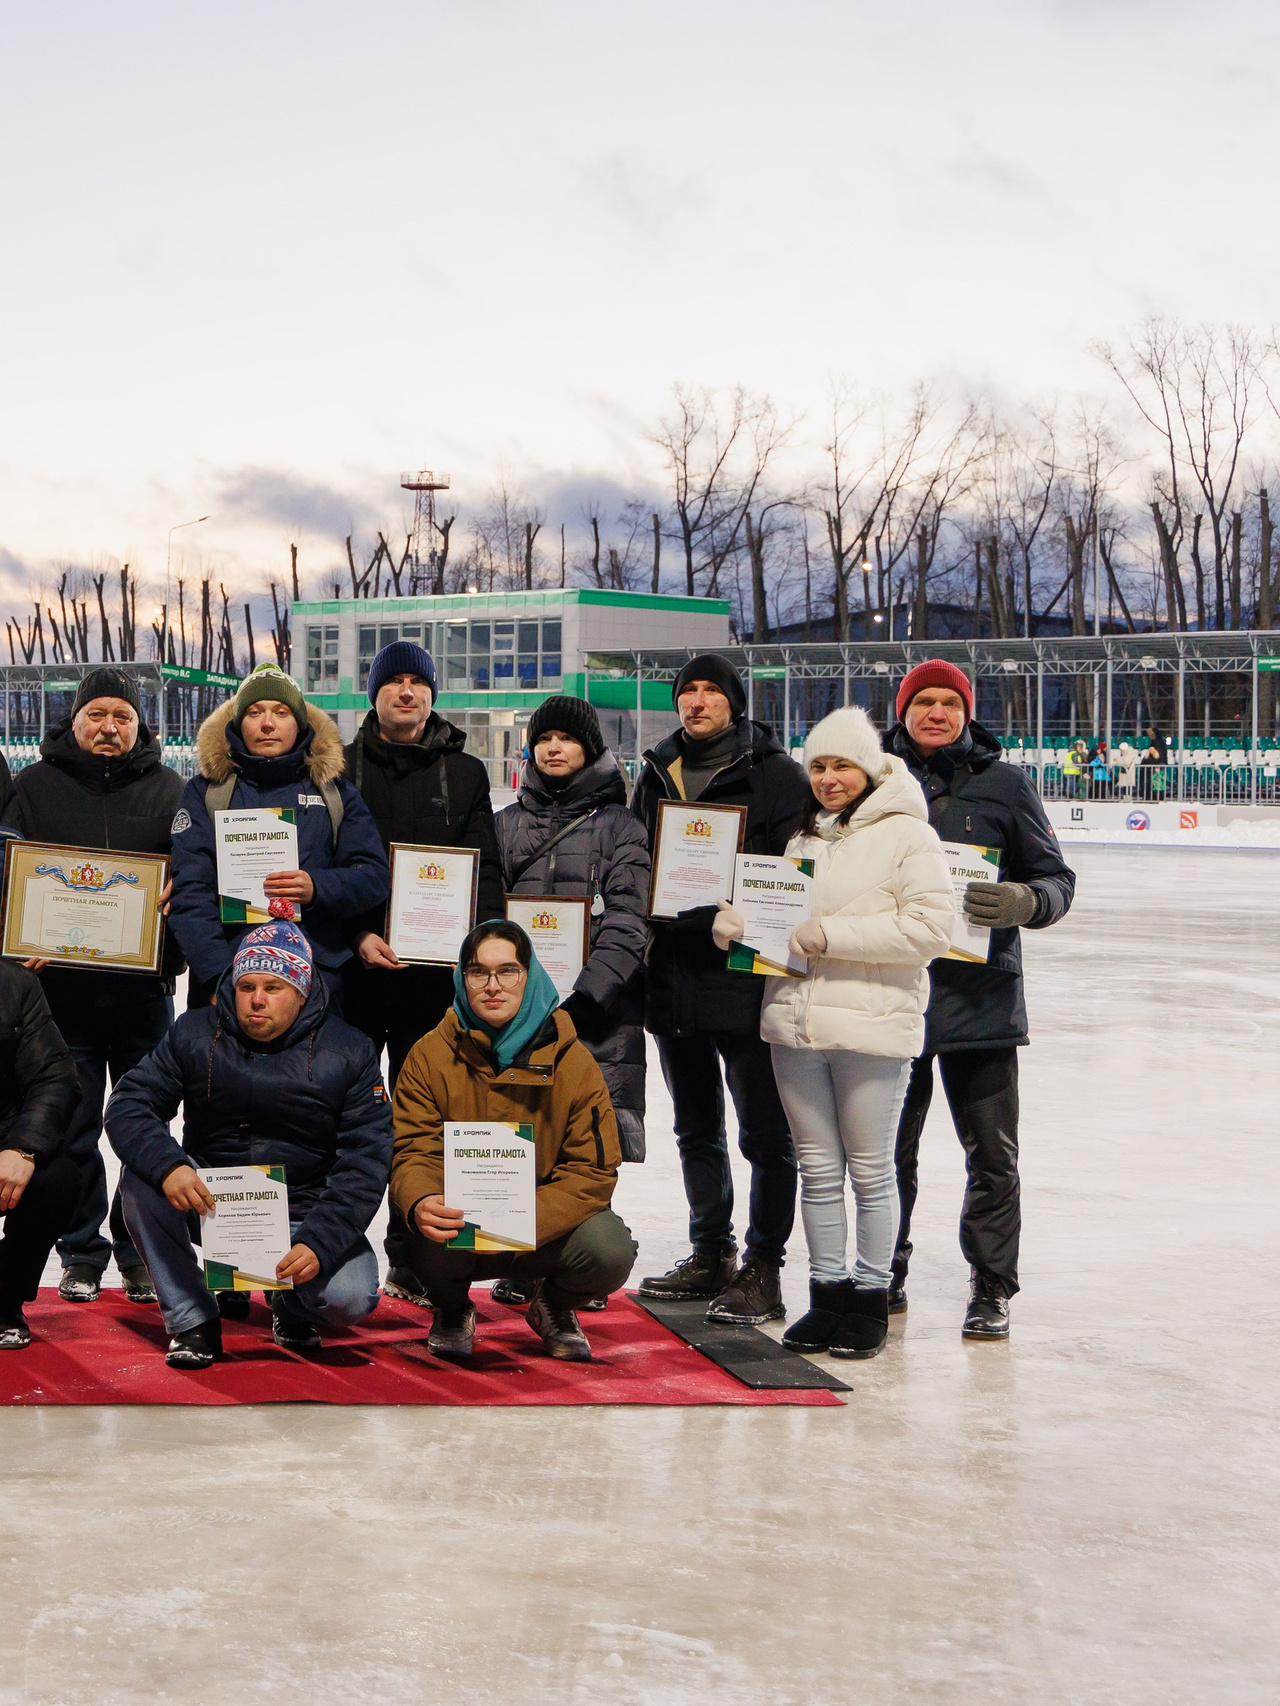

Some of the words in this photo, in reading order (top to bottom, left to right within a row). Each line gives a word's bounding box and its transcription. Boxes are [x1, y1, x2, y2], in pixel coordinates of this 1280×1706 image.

[206, 674, 238, 686] ЗАПАДНАЯ
[224, 833, 258, 842] ПОЧЕТНАЯ
[259, 832, 289, 840] ГРАМОТА
[958, 868, 989, 880] ГРАМОТА
[742, 878, 776, 890] ПОЧЕТНАЯ
[776, 882, 806, 892] ГРАМОТА
[52, 896, 88, 904] ПОЧЕТНАЯ
[88, 900, 118, 908] ГРАМОТА
[454, 1148, 490, 1158] ПОЧЕТНАЯ
[492, 1148, 526, 1158] ГРАМОТА
[246, 1190, 278, 1200] ГРАМОТА
